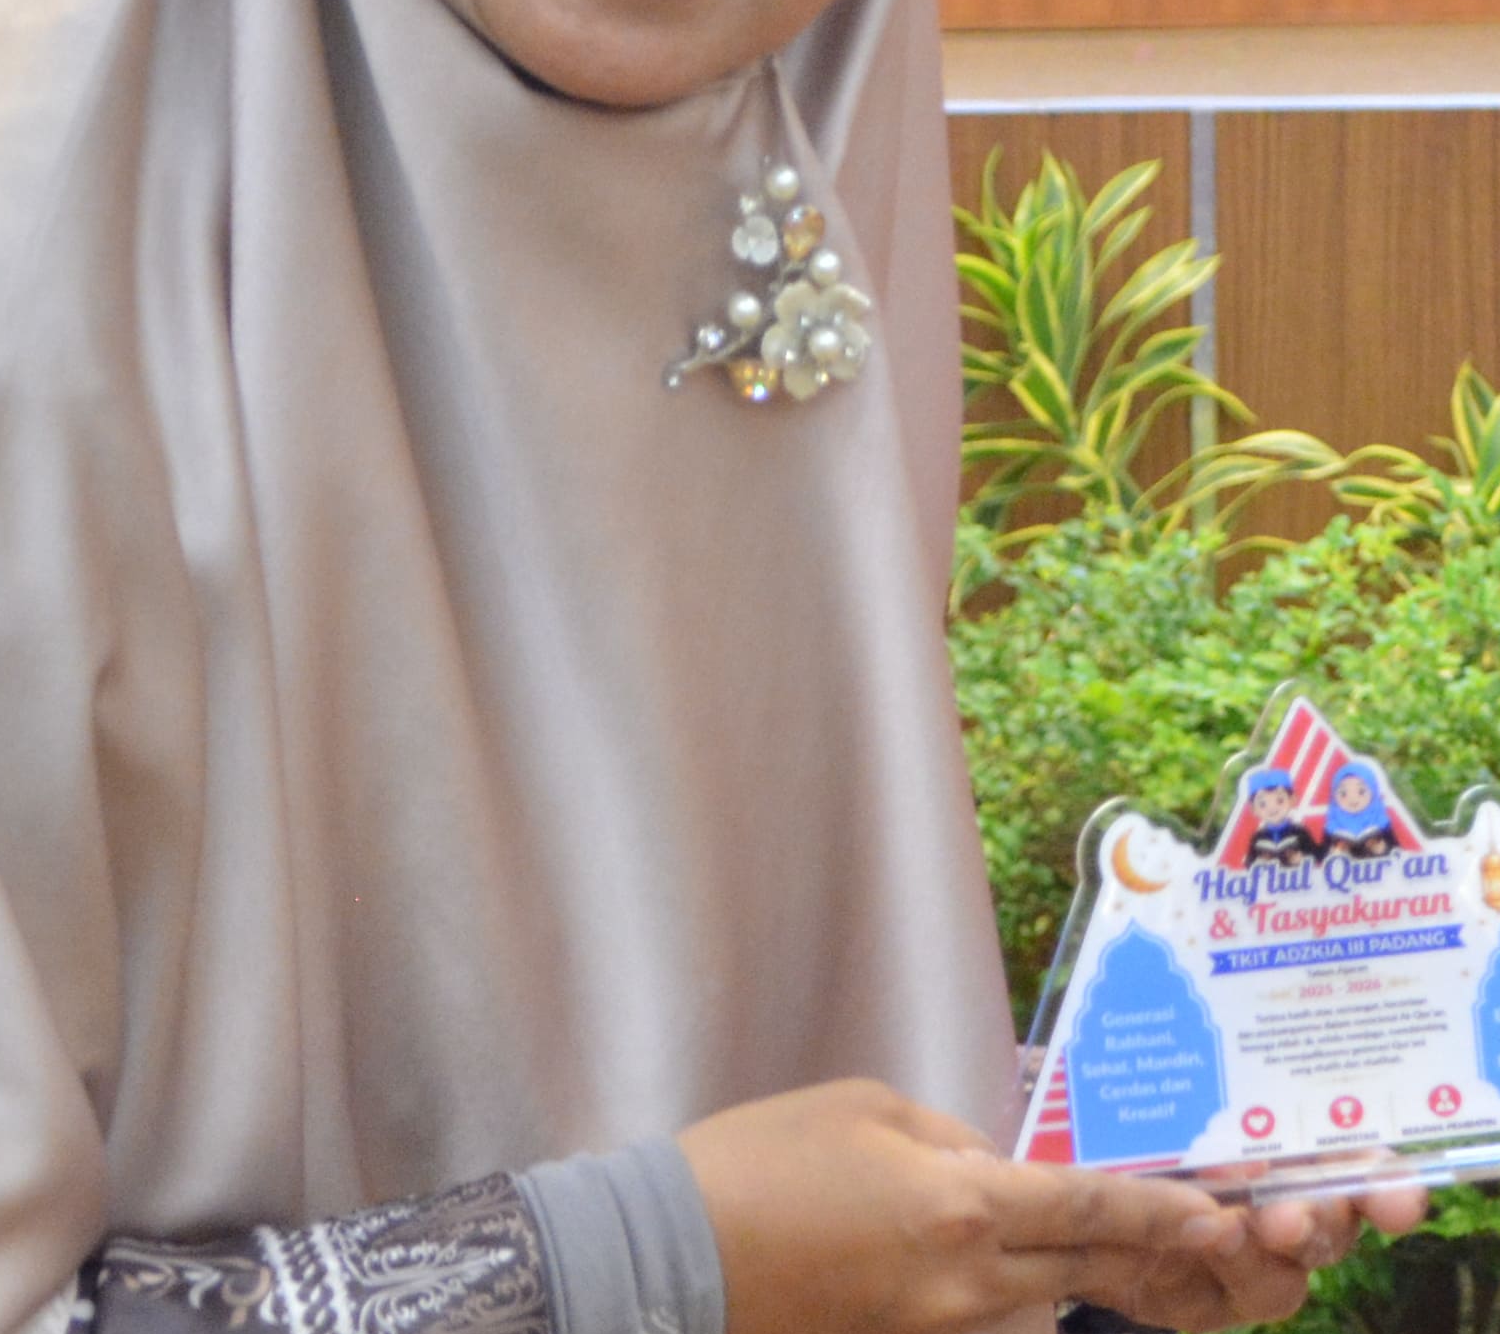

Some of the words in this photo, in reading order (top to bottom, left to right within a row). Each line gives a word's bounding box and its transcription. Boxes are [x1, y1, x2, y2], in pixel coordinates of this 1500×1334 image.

[1208, 908, 1237, 940] &
[1247, 892, 1453, 937] Tasyakuran
[1226, 951, 1270, 970] TKIT
[1275, 944, 1344, 965] ADZKIA
[1368, 930, 1446, 954] PADANG
